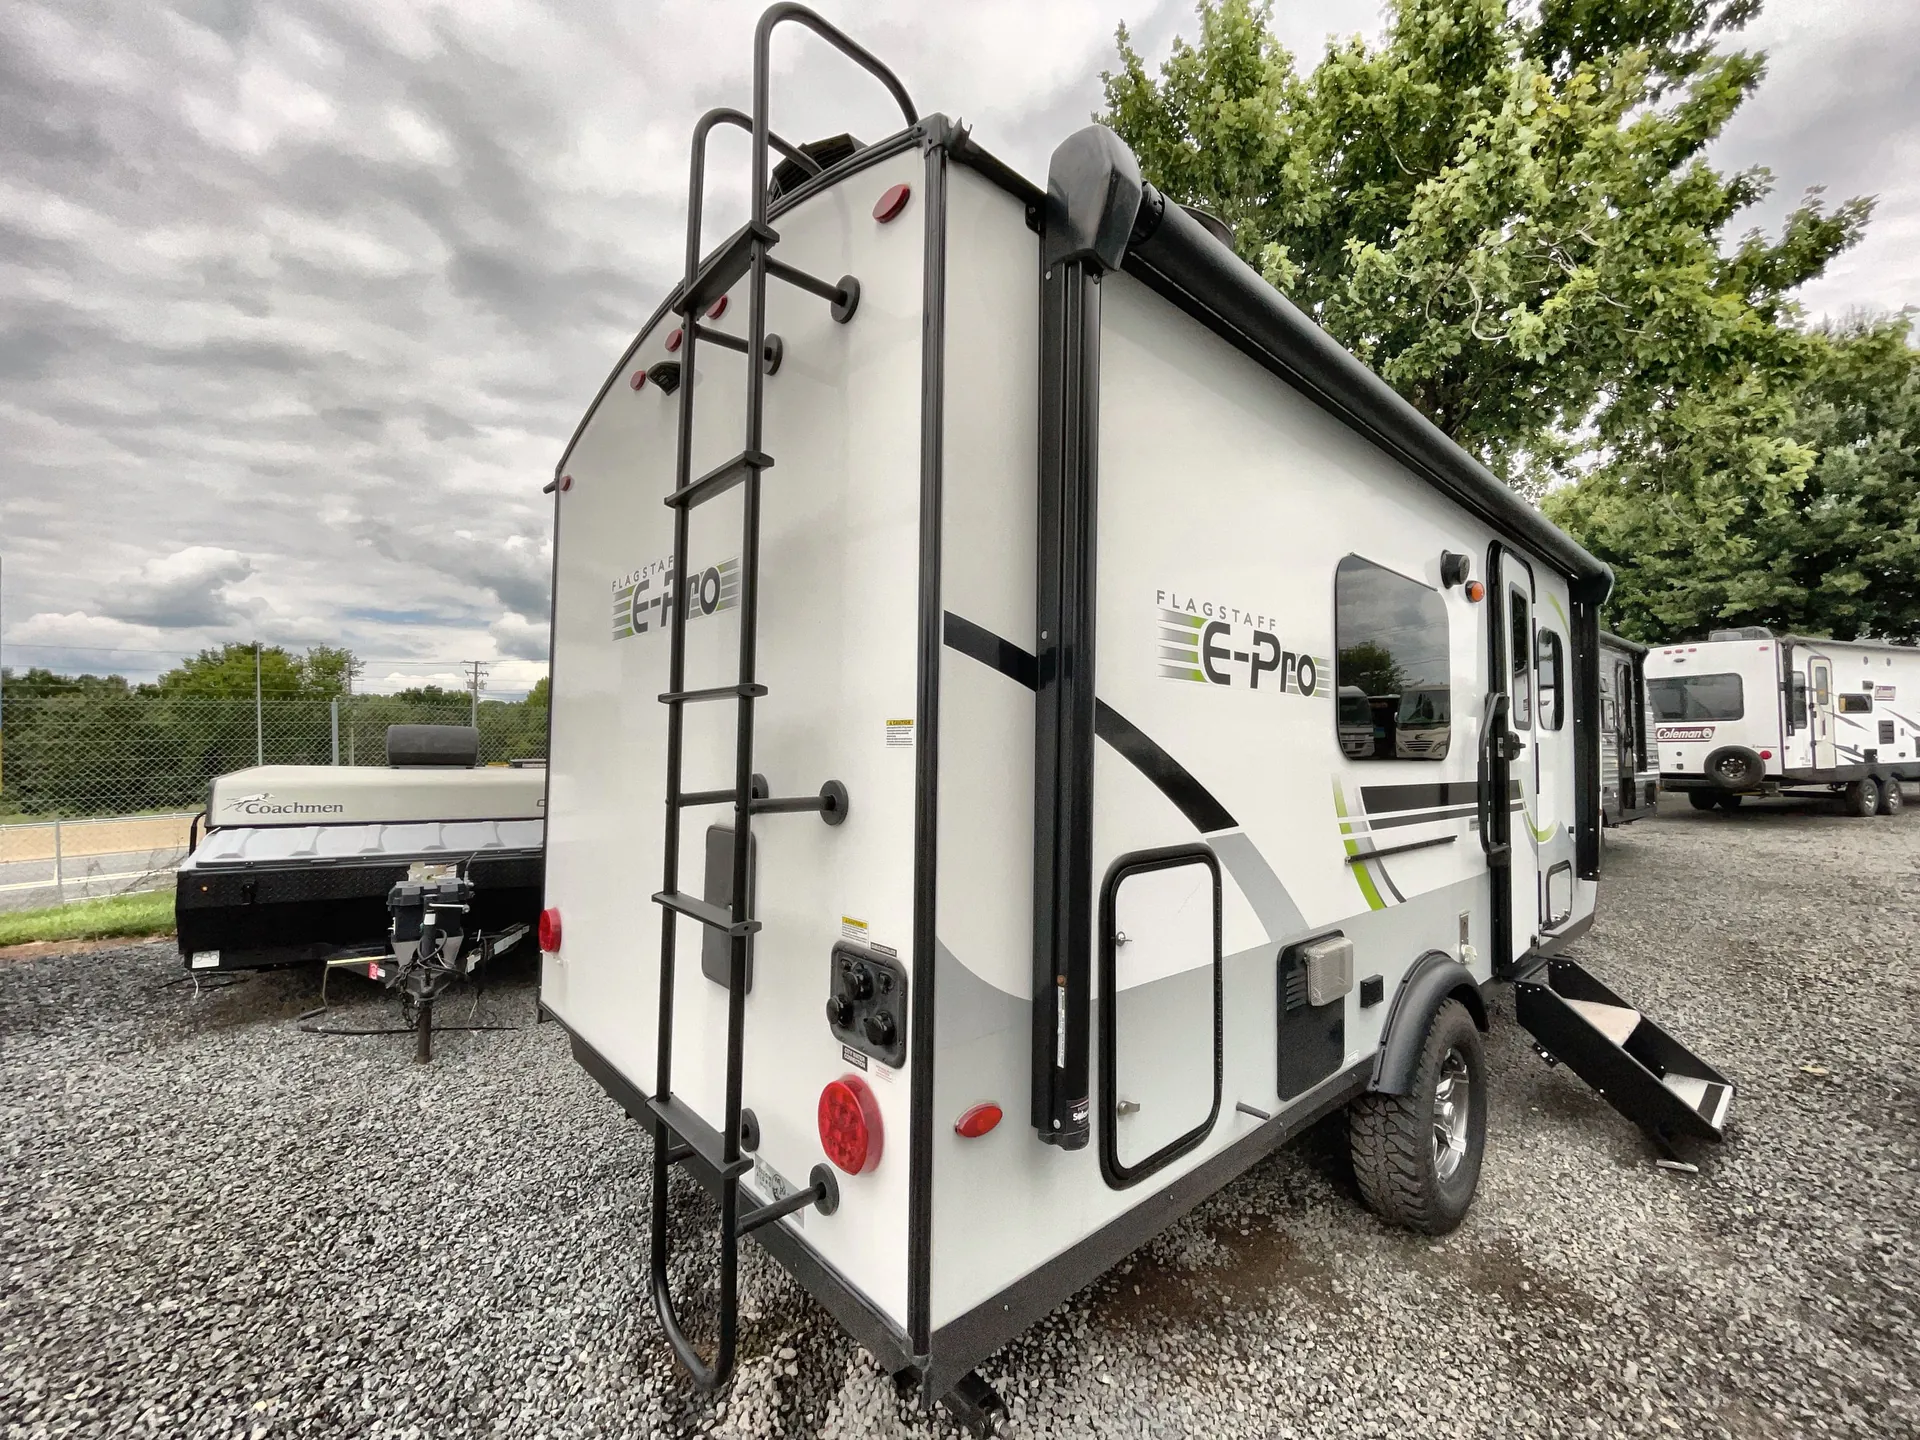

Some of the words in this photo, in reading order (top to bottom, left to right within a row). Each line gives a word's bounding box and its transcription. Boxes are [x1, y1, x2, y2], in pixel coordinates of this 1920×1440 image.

[611, 554, 675, 592] FLAGSTAF
[1156, 589, 1277, 631] FLAGSTAFF
[1202, 619, 1318, 697] E-Pro
[1656, 727, 1702, 739] Coleman
[245, 801, 344, 814] Coachmen
